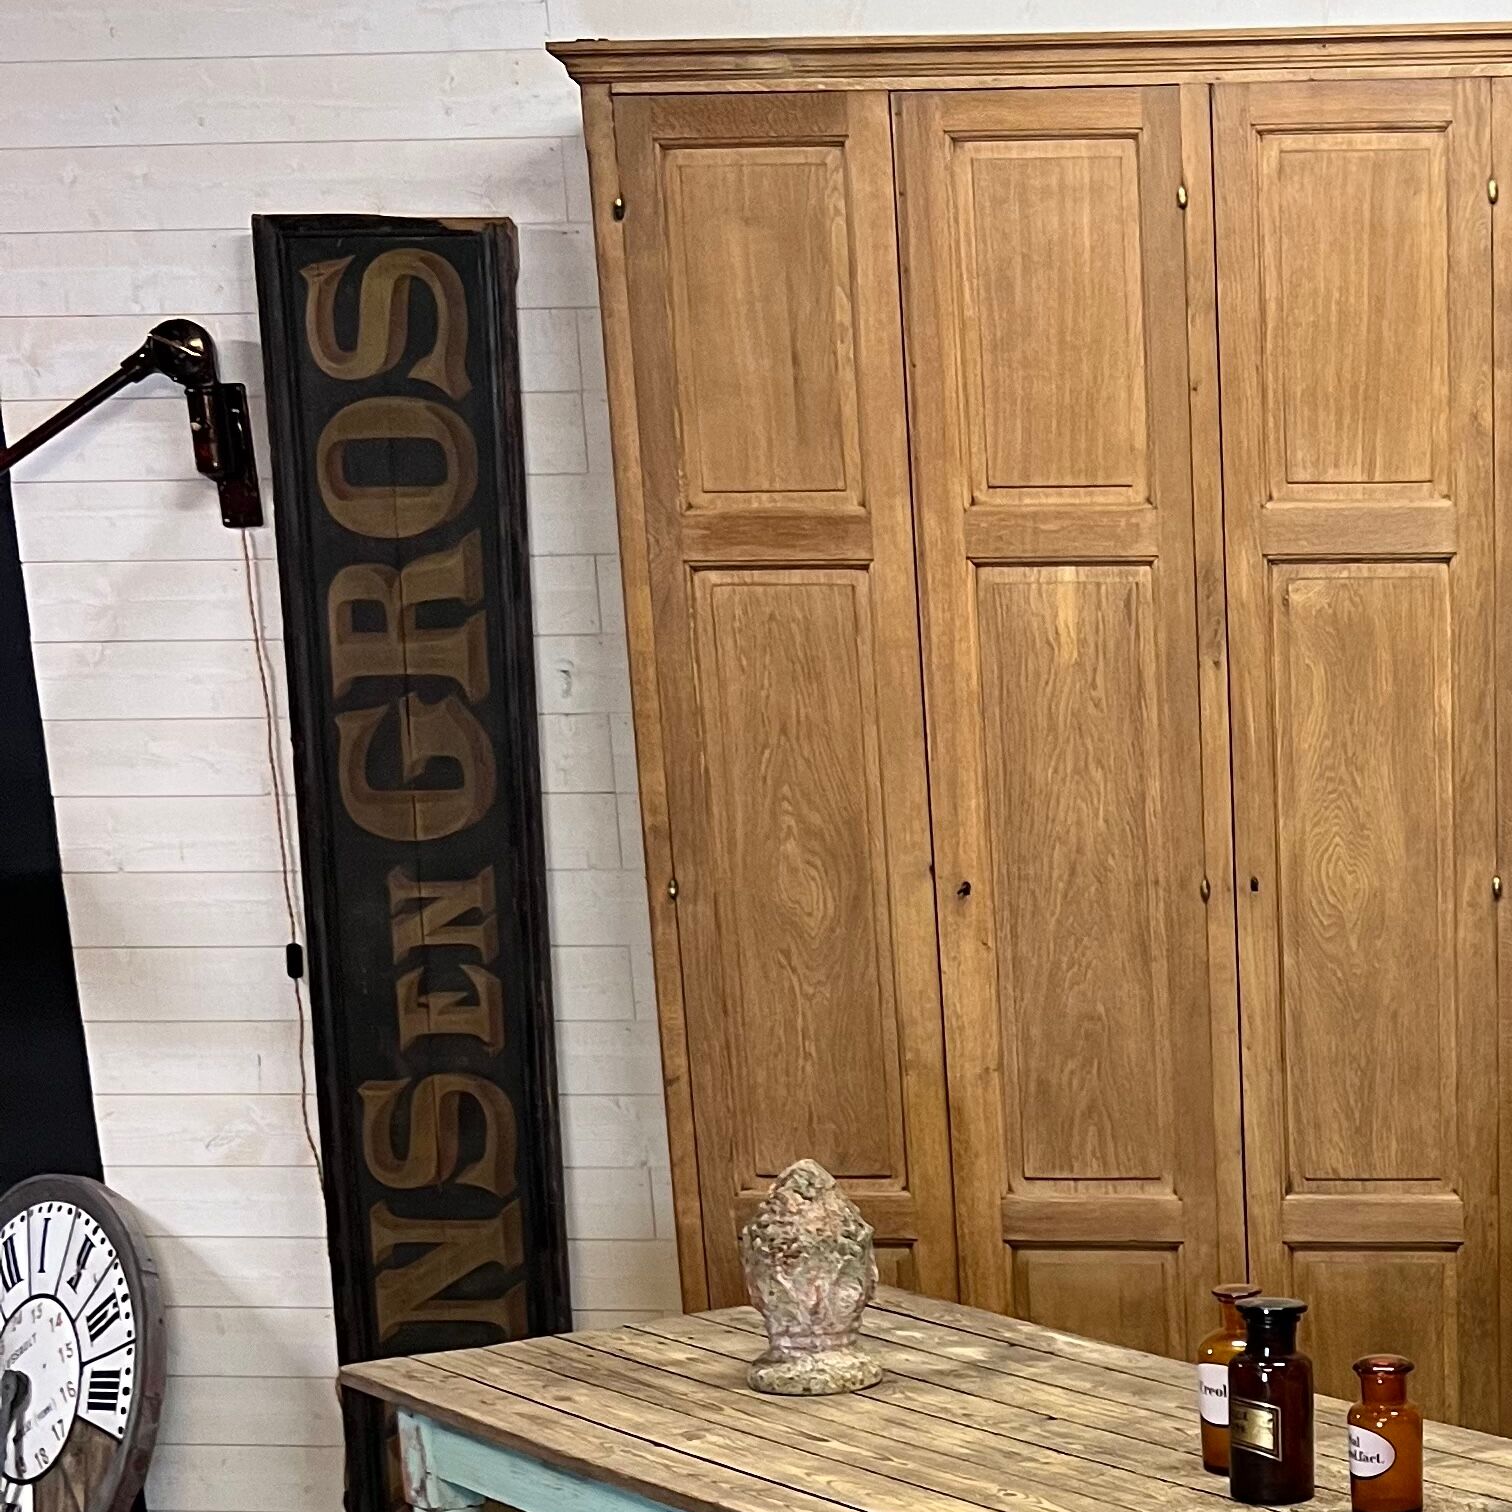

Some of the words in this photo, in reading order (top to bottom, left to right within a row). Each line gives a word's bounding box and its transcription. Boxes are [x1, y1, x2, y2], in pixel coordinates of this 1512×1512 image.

[300, 247, 497, 841] GROS
[387, 864, 506, 1057] EN
[38, 1217, 52, 1273] I
[86, 1288, 122, 1347] III
[59, 1341, 74, 1363] 15
[60, 1380, 76, 1403] 16
[87, 1368, 122, 1413] IIII
[52, 1418, 66, 1441] 17
[34, 1447, 50, 1470] 18
